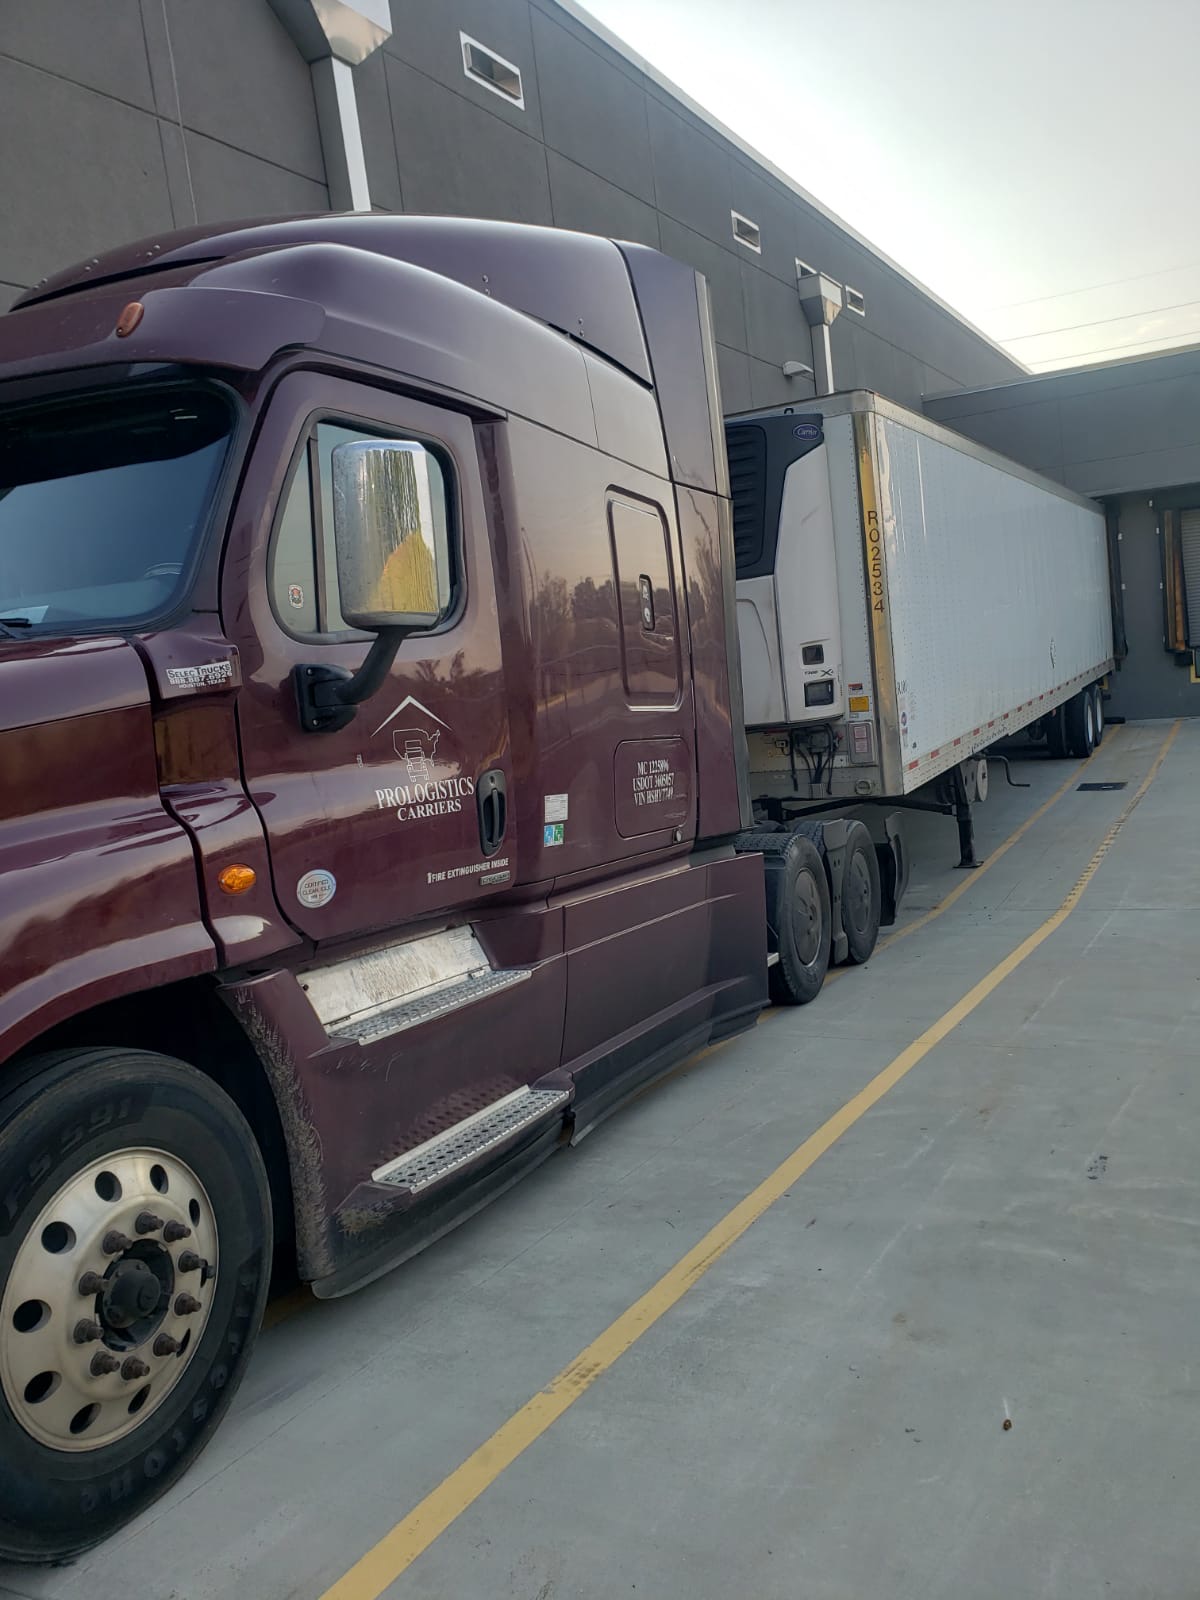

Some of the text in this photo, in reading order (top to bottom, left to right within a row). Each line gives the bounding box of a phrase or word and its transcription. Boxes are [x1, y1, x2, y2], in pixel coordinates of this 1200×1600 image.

[867, 510, 885, 613] R02534
[207, 678, 226, 686] TEXAS
[637, 761, 648, 776] MC
[375, 776, 474, 809] PROLOGISTICS
[632, 775, 654, 792] USDOT
[633, 791, 646, 807] VIN
[397, 799, 462, 821] CARRIERS
[431, 871, 446, 882] FIRE
[447, 862, 490, 879] EXTINGUISHER
[491, 858, 509, 869] INSIDE
